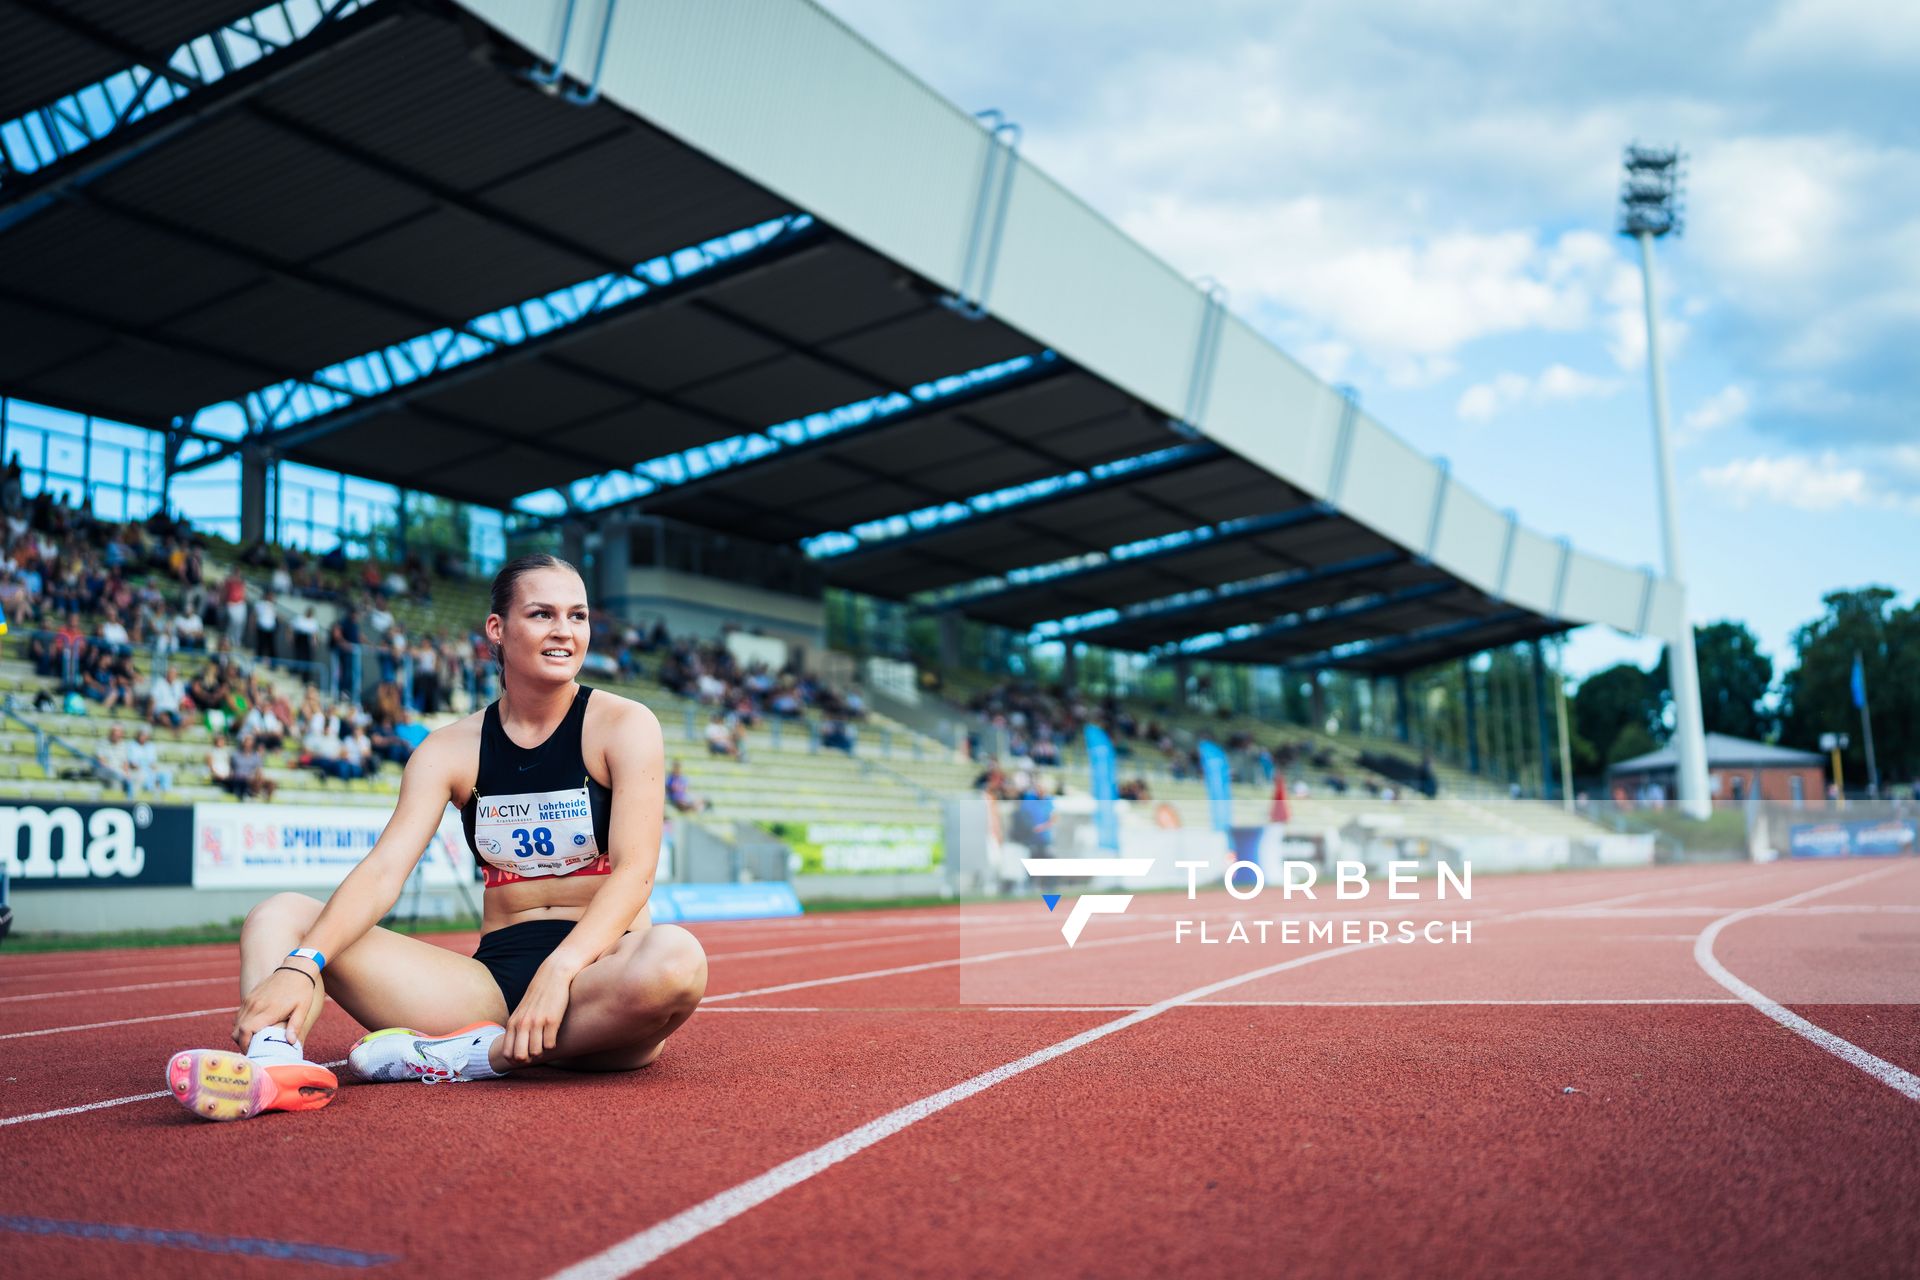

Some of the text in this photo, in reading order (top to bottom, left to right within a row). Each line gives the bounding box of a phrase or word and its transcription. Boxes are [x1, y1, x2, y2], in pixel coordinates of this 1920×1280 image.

[478, 803, 530, 818] VIACTIV
[538, 799, 586, 810] Lohrheide
[539, 808, 588, 820] MEETING
[511, 827, 555, 858] 38
